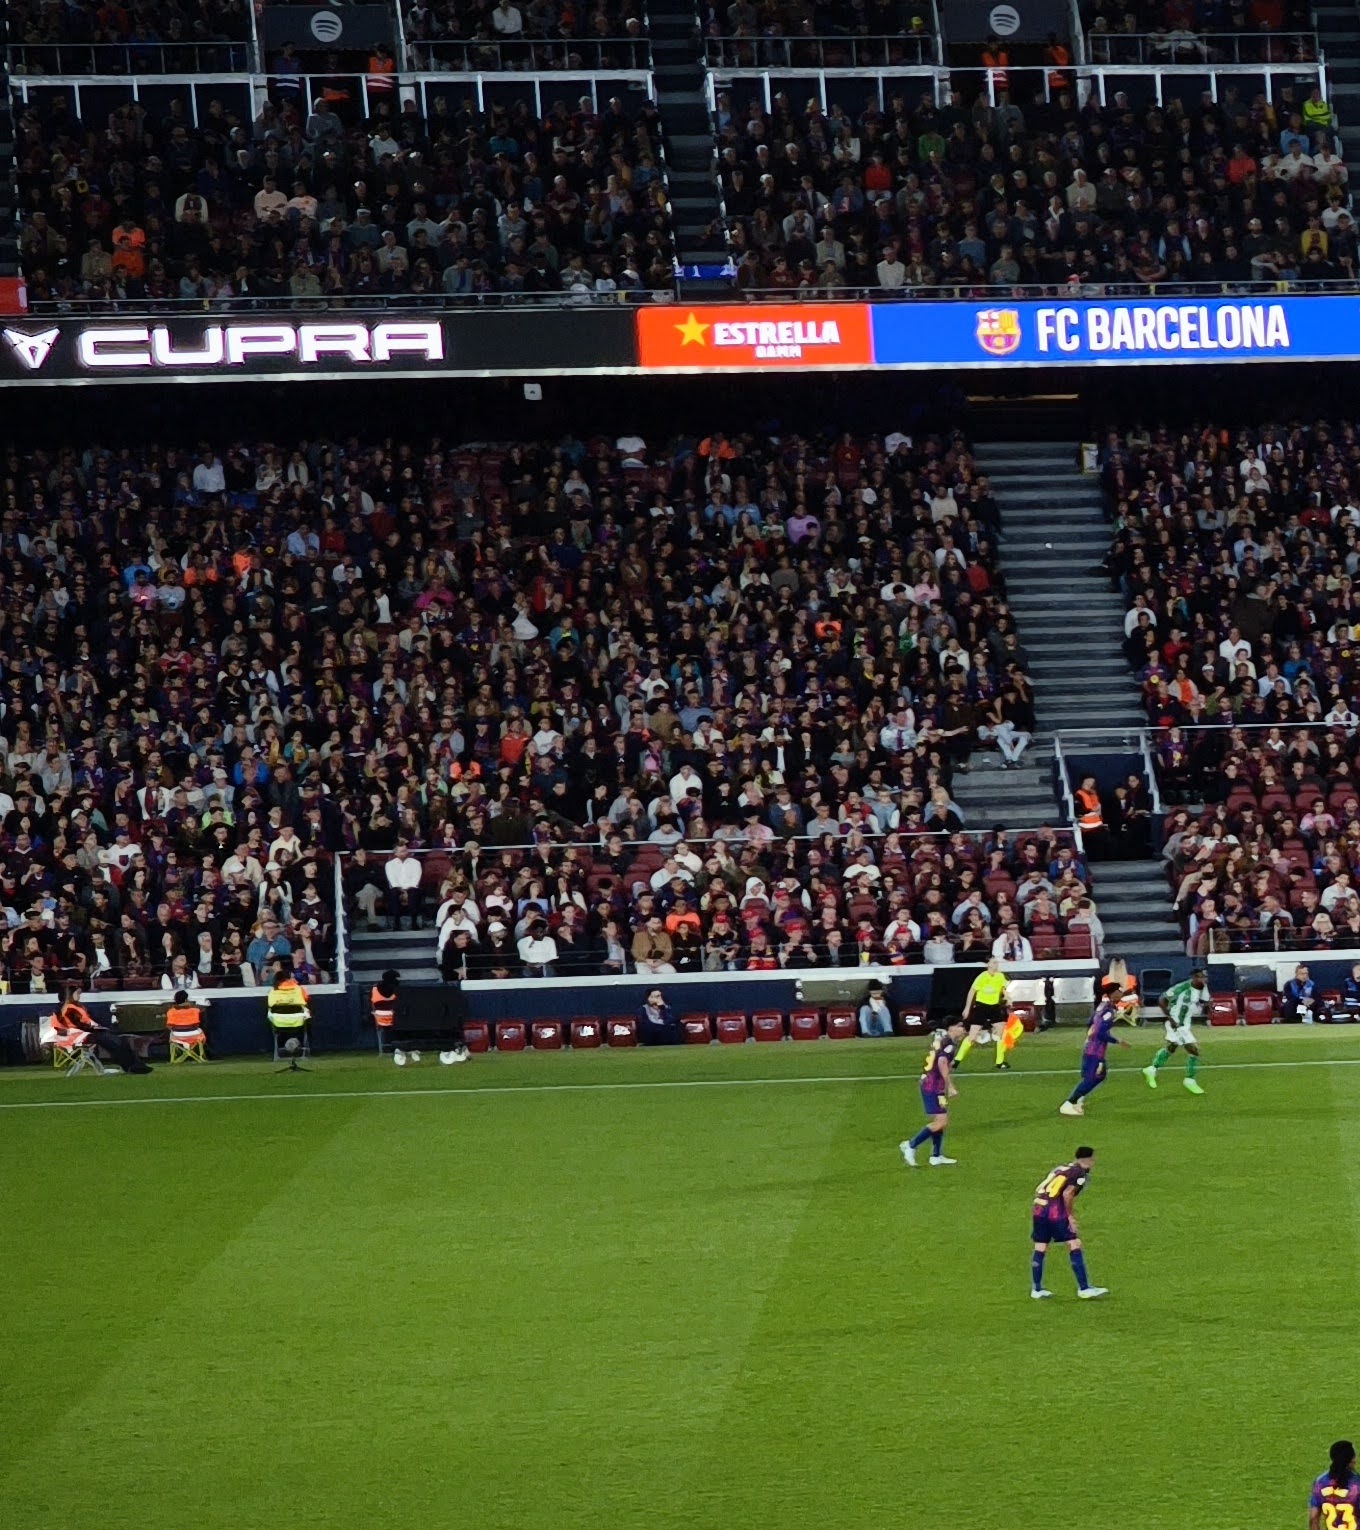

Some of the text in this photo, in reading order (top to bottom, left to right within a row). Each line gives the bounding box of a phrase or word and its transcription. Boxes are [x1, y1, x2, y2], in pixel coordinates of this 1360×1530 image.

[79, 322, 445, 367] CUPRA
[714, 321, 841, 346] ESTRELLA
[1036, 304, 1291, 352] FC BARCELONA
